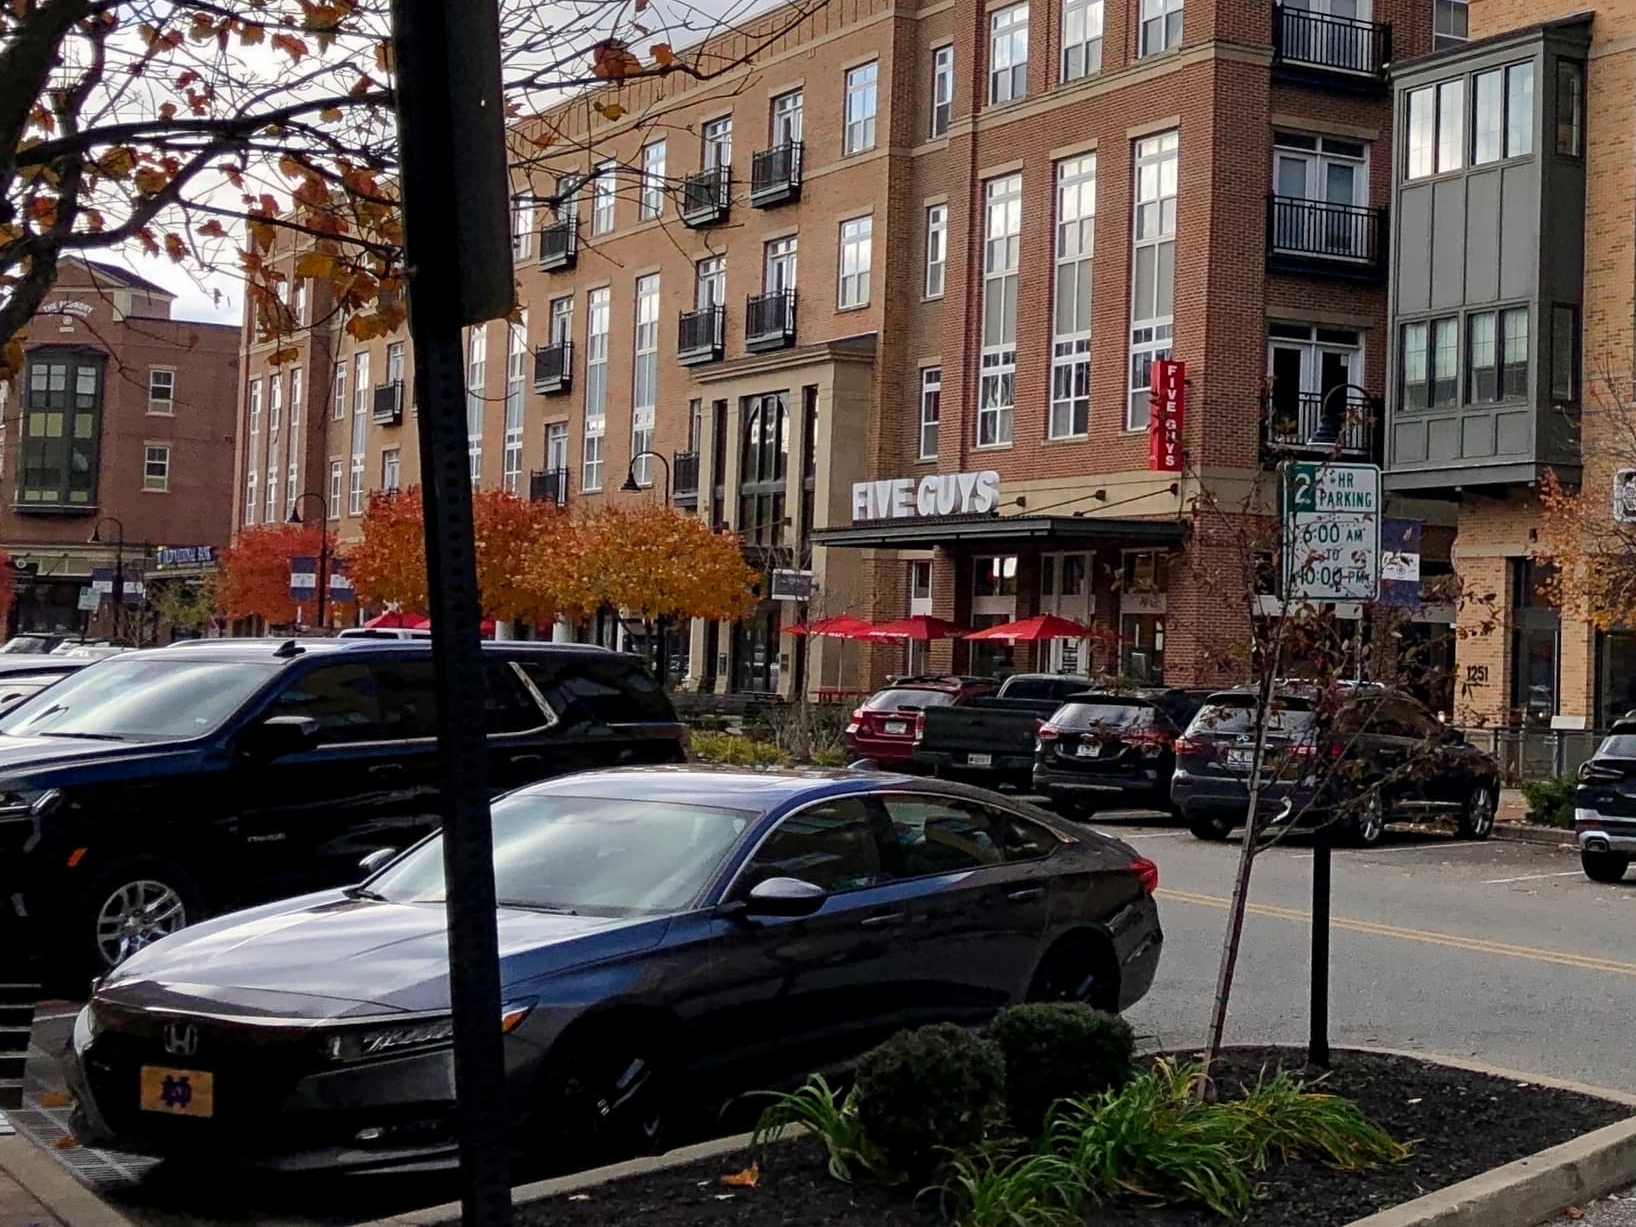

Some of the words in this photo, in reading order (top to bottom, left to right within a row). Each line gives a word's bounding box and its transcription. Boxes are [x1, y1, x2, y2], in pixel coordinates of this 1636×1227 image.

[1166, 364, 1178, 413] FIVE
[1294, 473, 1311, 504] 2
[1338, 472, 1354, 488] HR
[853, 478, 913, 521] FIVE
[917, 471, 999, 516] GUYS
[1320, 491, 1372, 508] PARKING
[1346, 529, 1363, 542] AM
[1466, 665, 1489, 683] 1251
